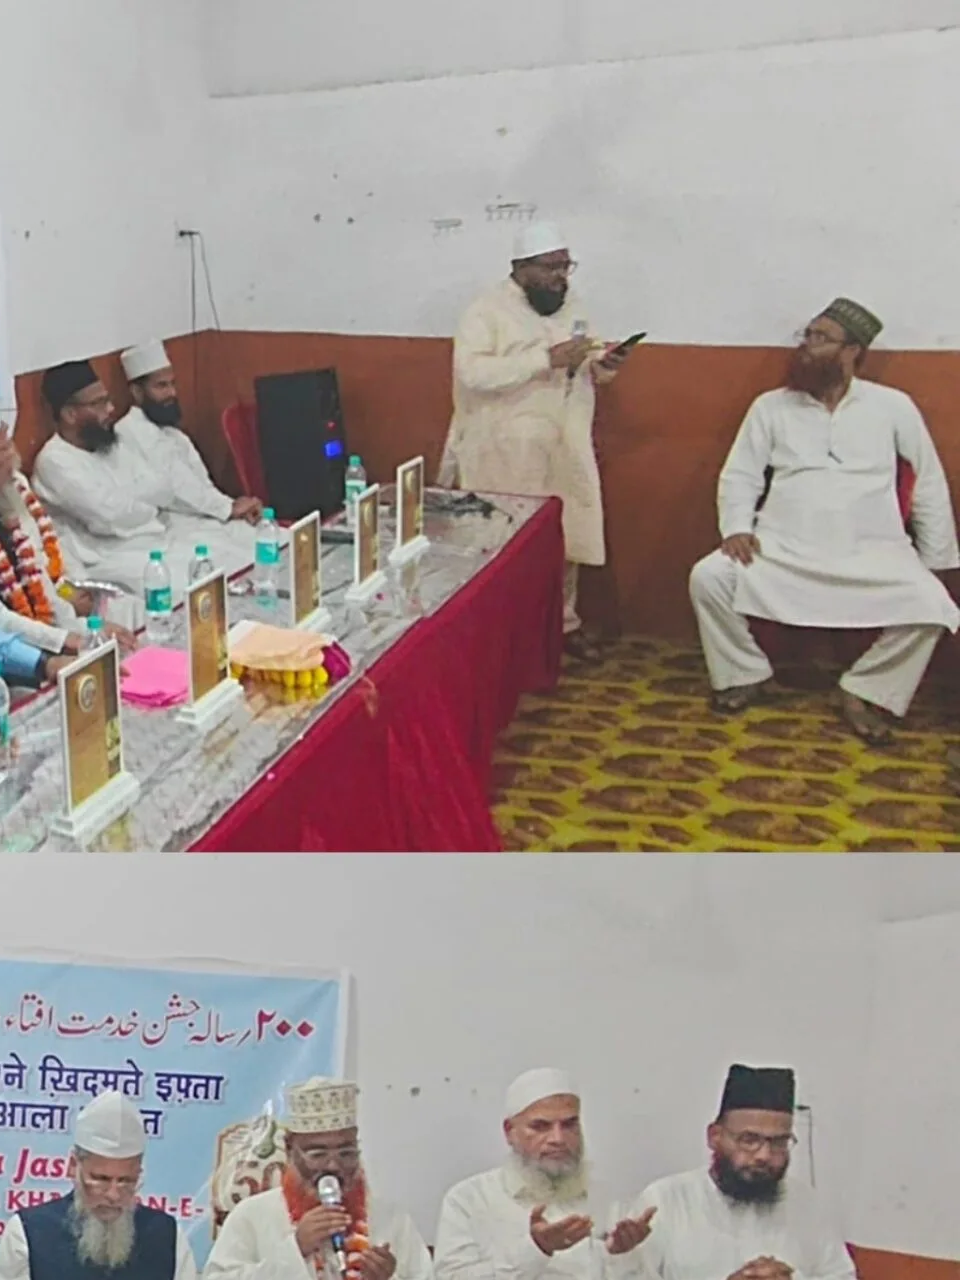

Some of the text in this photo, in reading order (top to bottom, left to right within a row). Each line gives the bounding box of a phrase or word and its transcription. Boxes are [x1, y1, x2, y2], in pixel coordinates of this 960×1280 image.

[6, 993, 54, 1032] افتاء
[57, 1011, 139, 1037] خدمت
[142, 994, 201, 1045] جشن
